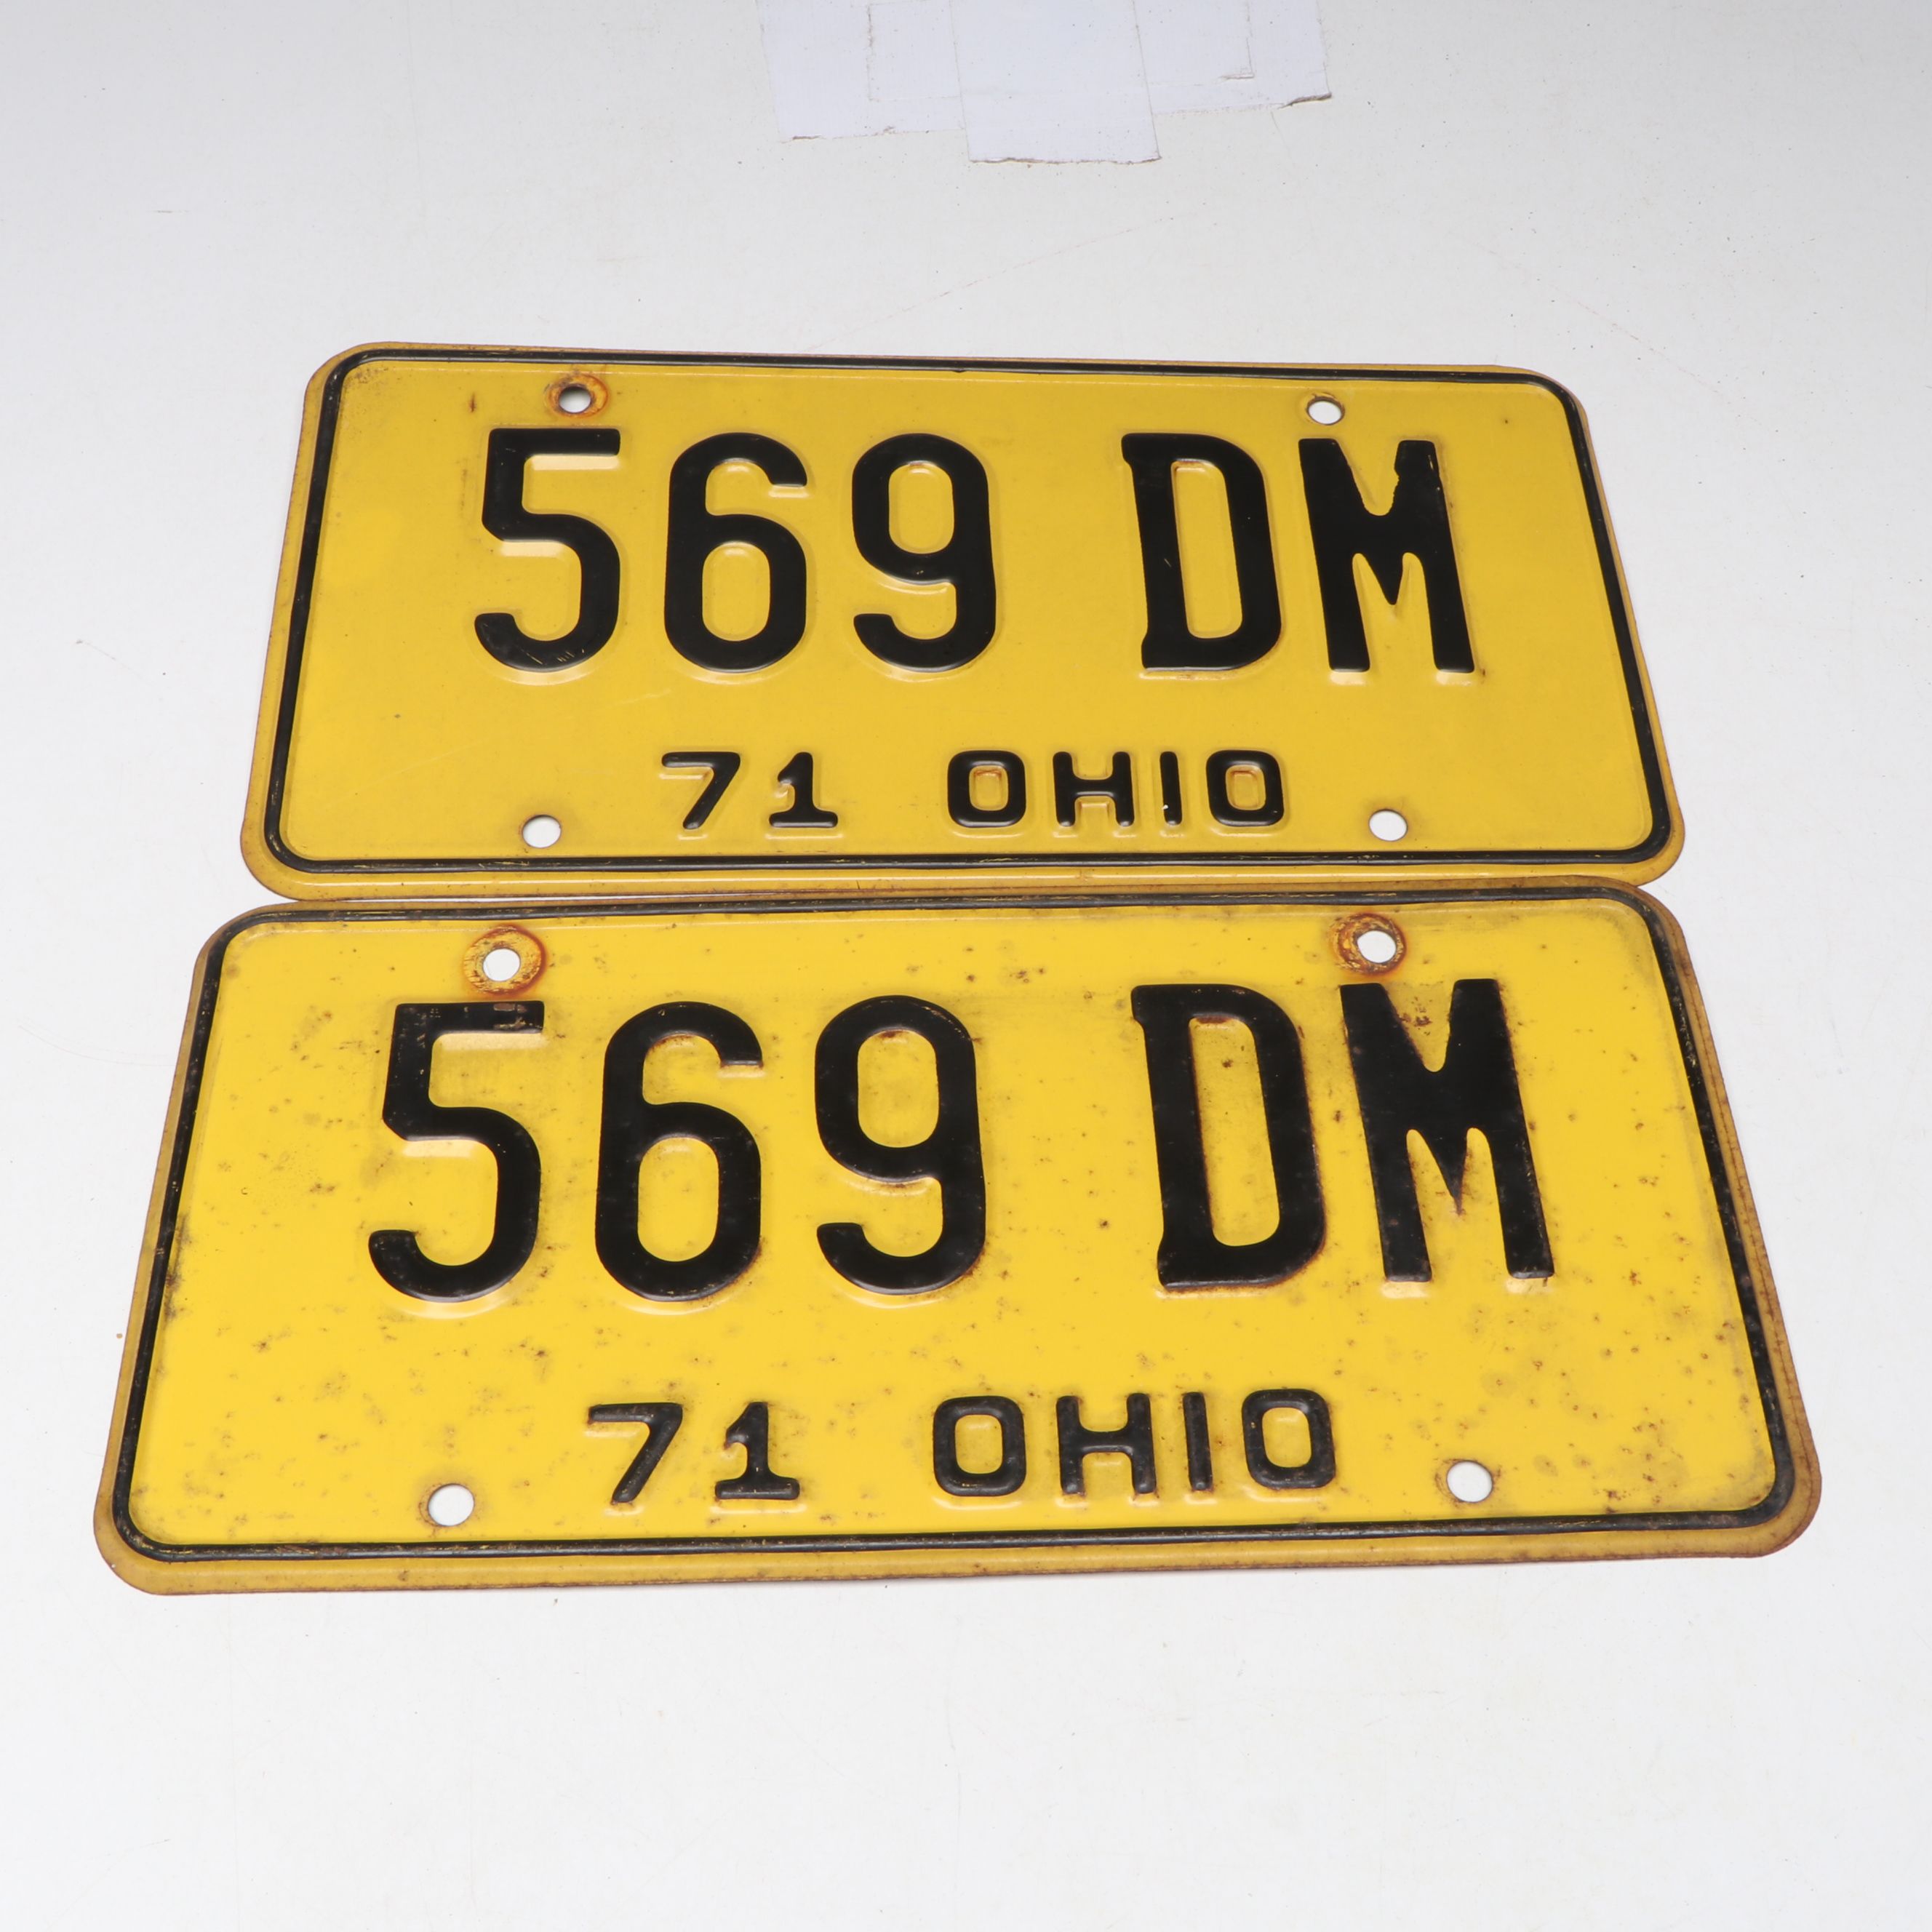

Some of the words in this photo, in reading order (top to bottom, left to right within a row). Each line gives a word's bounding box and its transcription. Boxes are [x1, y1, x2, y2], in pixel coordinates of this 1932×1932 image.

[474, 427, 997, 670] 569
[1121, 432, 1474, 674] DM
[661, 751, 838, 827] 71
[947, 749, 1285, 826] OHIO
[367, 994, 986, 1298] 569
[1130, 978, 1555, 1288] DM
[588, 1401, 800, 1501] 71
[933, 1389, 1336, 1496] OHIO
